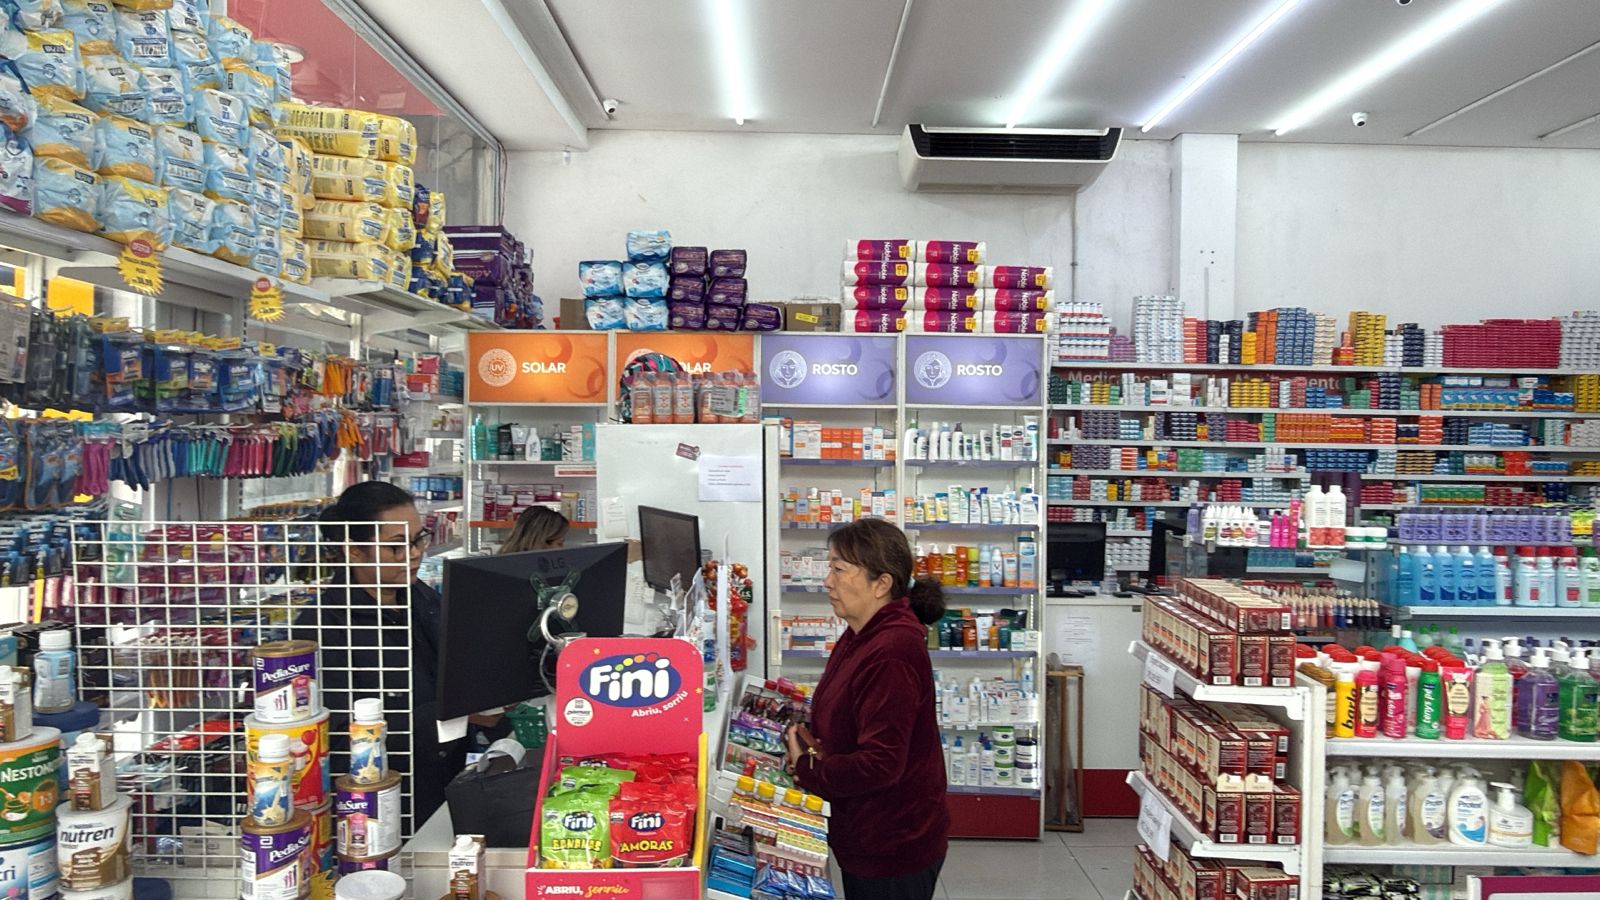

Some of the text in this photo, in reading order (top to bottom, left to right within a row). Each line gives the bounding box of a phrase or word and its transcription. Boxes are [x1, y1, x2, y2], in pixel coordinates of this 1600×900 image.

[491, 364, 504, 372] UV
[522, 361, 566, 374] SOLAR
[812, 364, 858, 377] ROSTO
[957, 364, 1003, 377] ROSTO
[262, 663, 311, 683] PediaSure
[589, 658, 670, 701] Fini
[631, 690, 689, 718] Abriu, sorriu
[1422, 701, 1433, 724] tenys
[564, 812, 594, 829] Fini
[631, 812, 661, 830] Fini
[60, 827, 115, 843] nutren
[620, 839, 674, 853] AMORAS
[544, 885, 584, 896] ABRIU,
